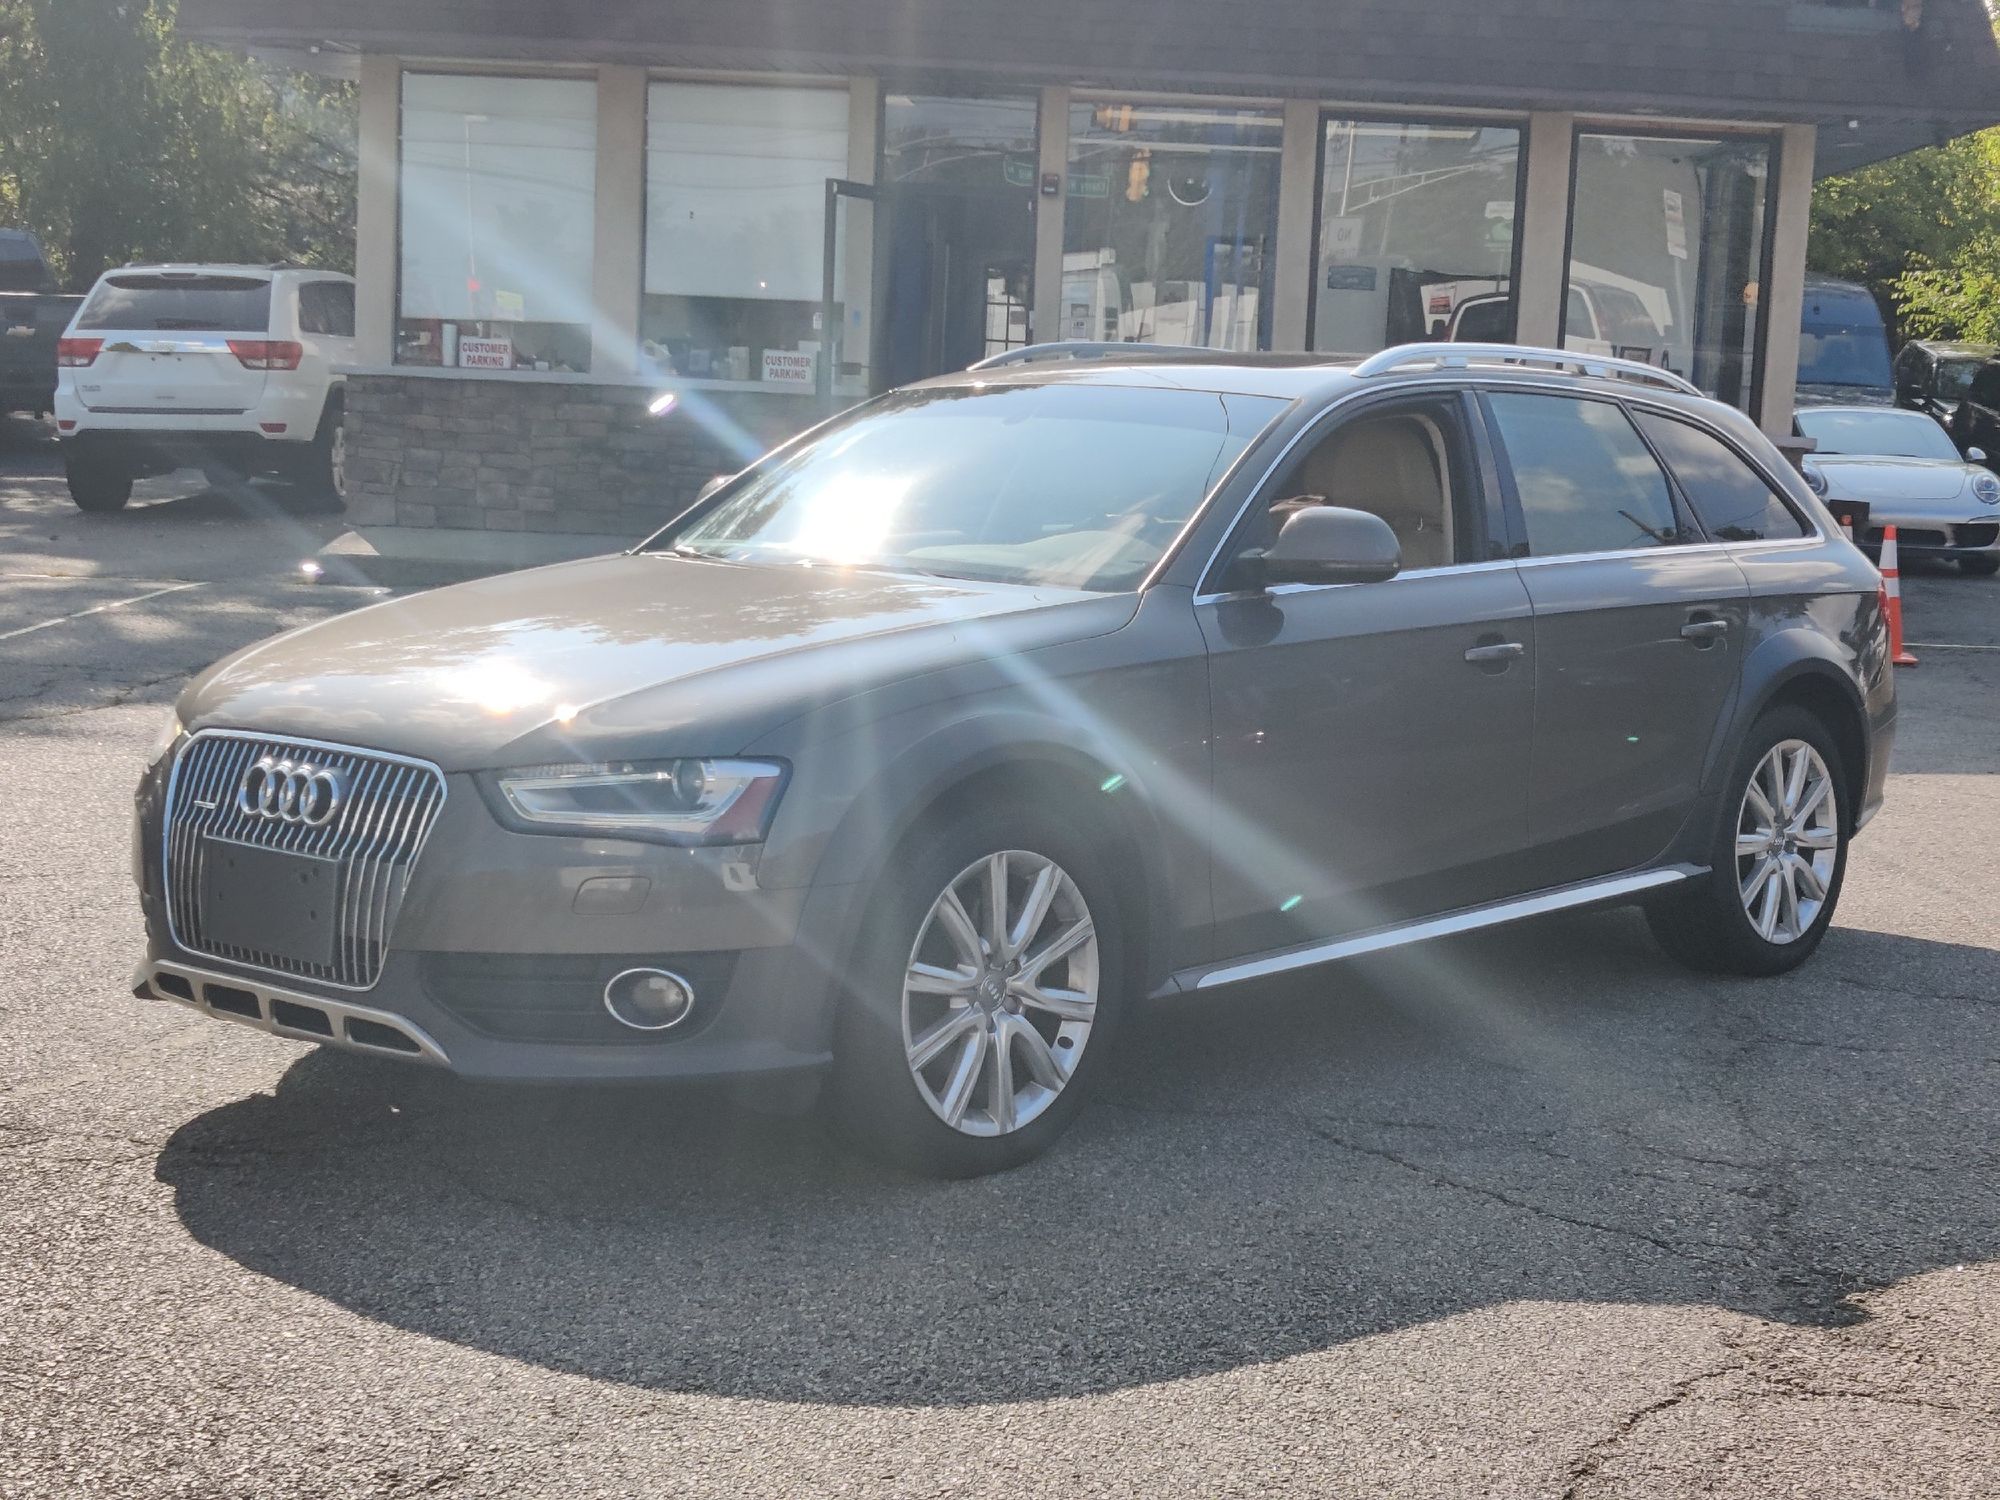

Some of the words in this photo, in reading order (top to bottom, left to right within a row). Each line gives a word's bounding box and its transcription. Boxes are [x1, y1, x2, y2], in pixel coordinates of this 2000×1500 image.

[462, 342, 508, 354] CUSTOMER
[466, 355, 504, 367] PARKING
[765, 355, 811, 368] CUSTOMER
[769, 368, 806, 380] PARKING
